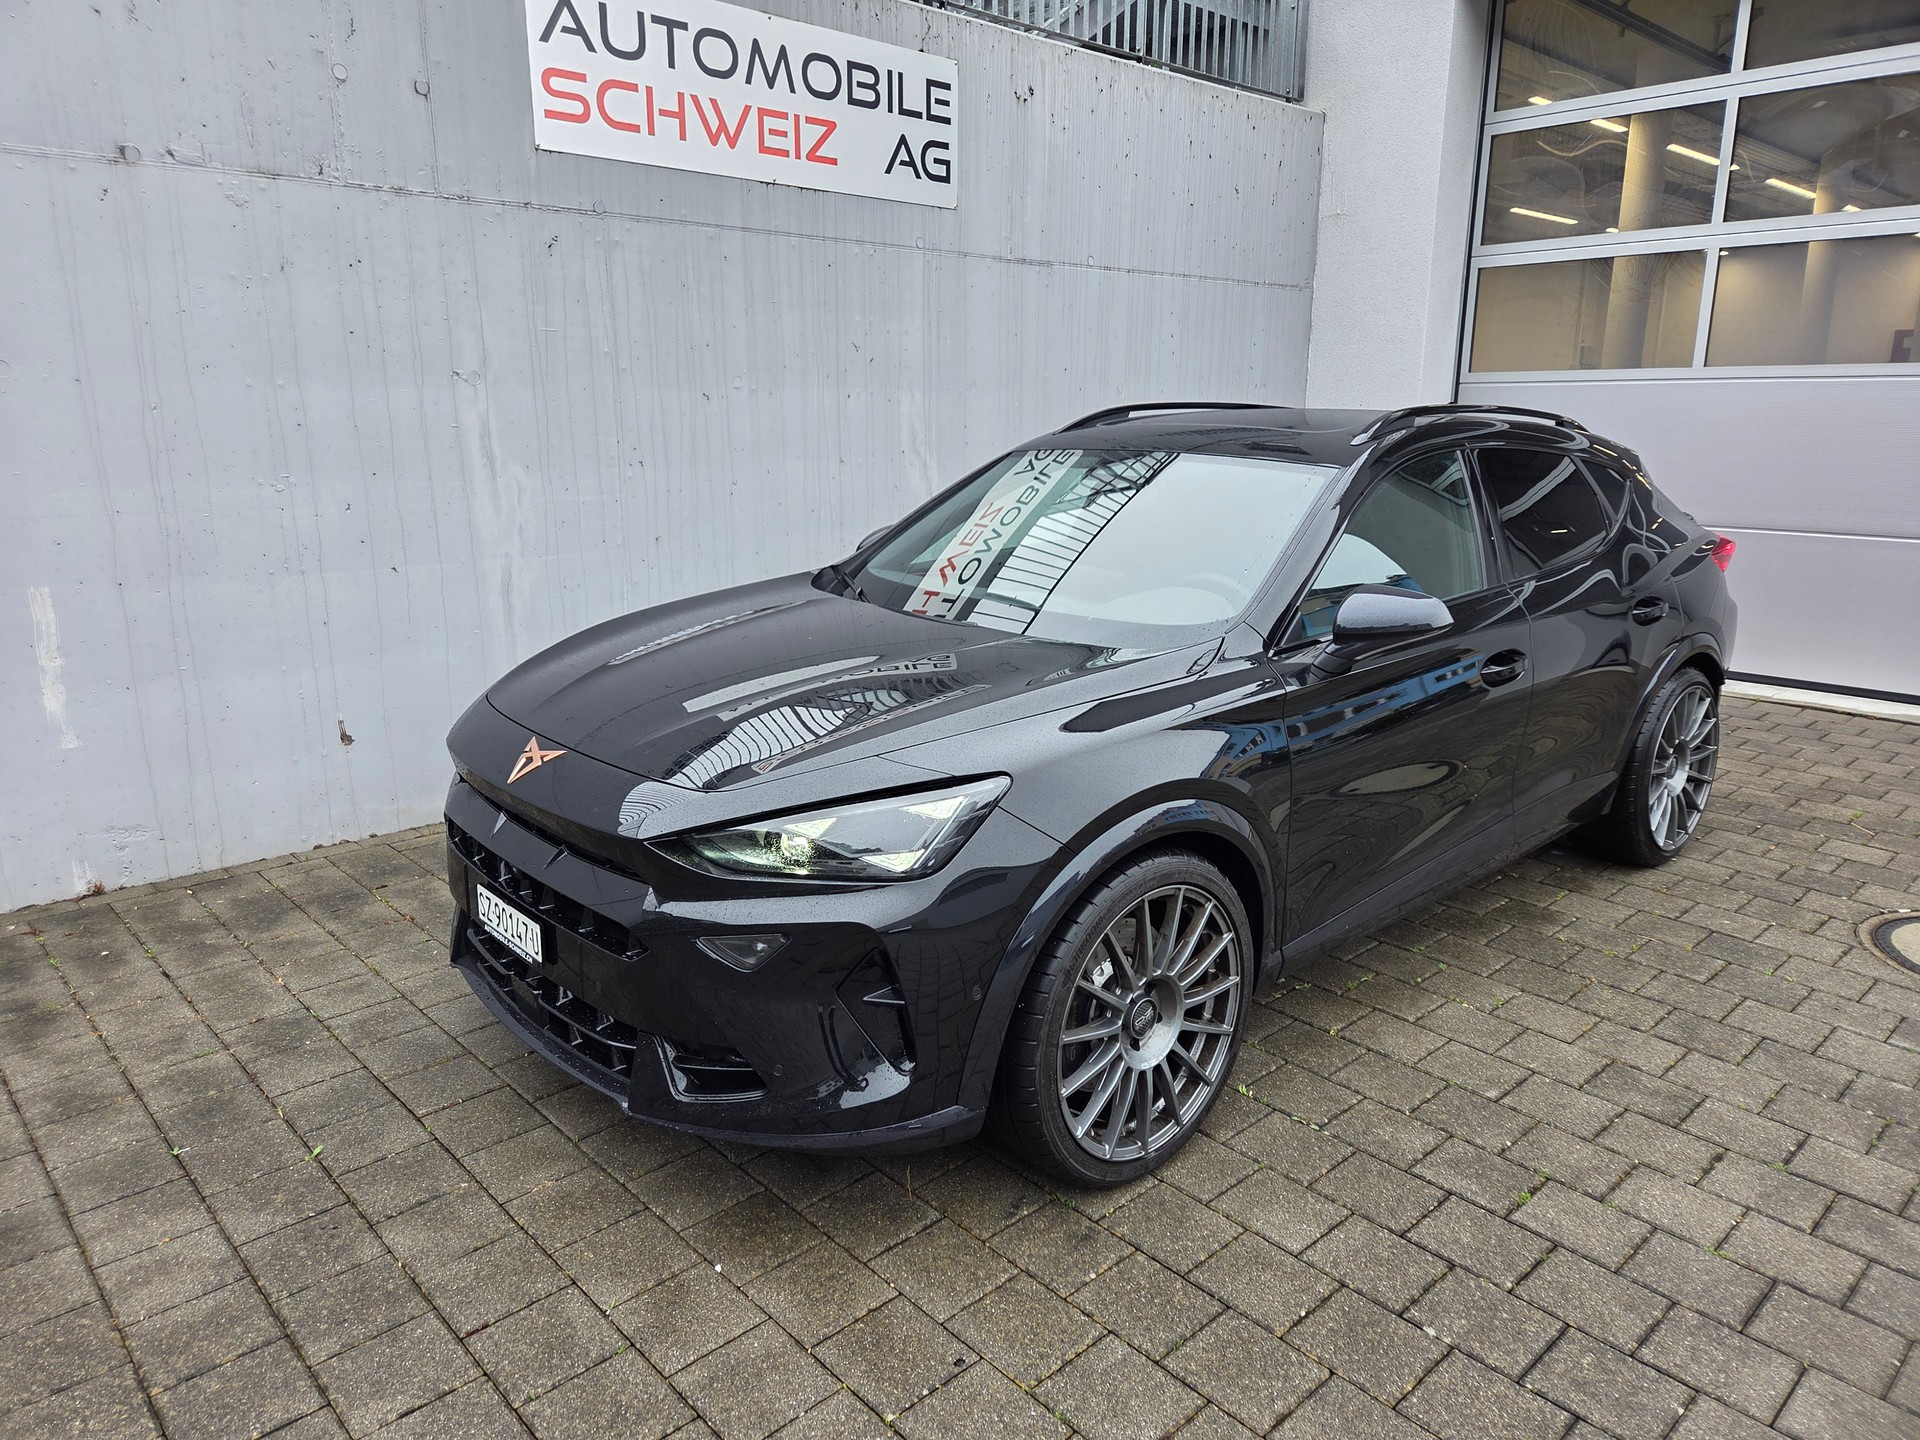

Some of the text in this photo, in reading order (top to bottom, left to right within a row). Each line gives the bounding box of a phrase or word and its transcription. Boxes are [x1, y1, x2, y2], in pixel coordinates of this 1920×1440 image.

[538, 0, 952, 126] AUTOMOBILE
[541, 67, 951, 184] SCHWEIZ AG
